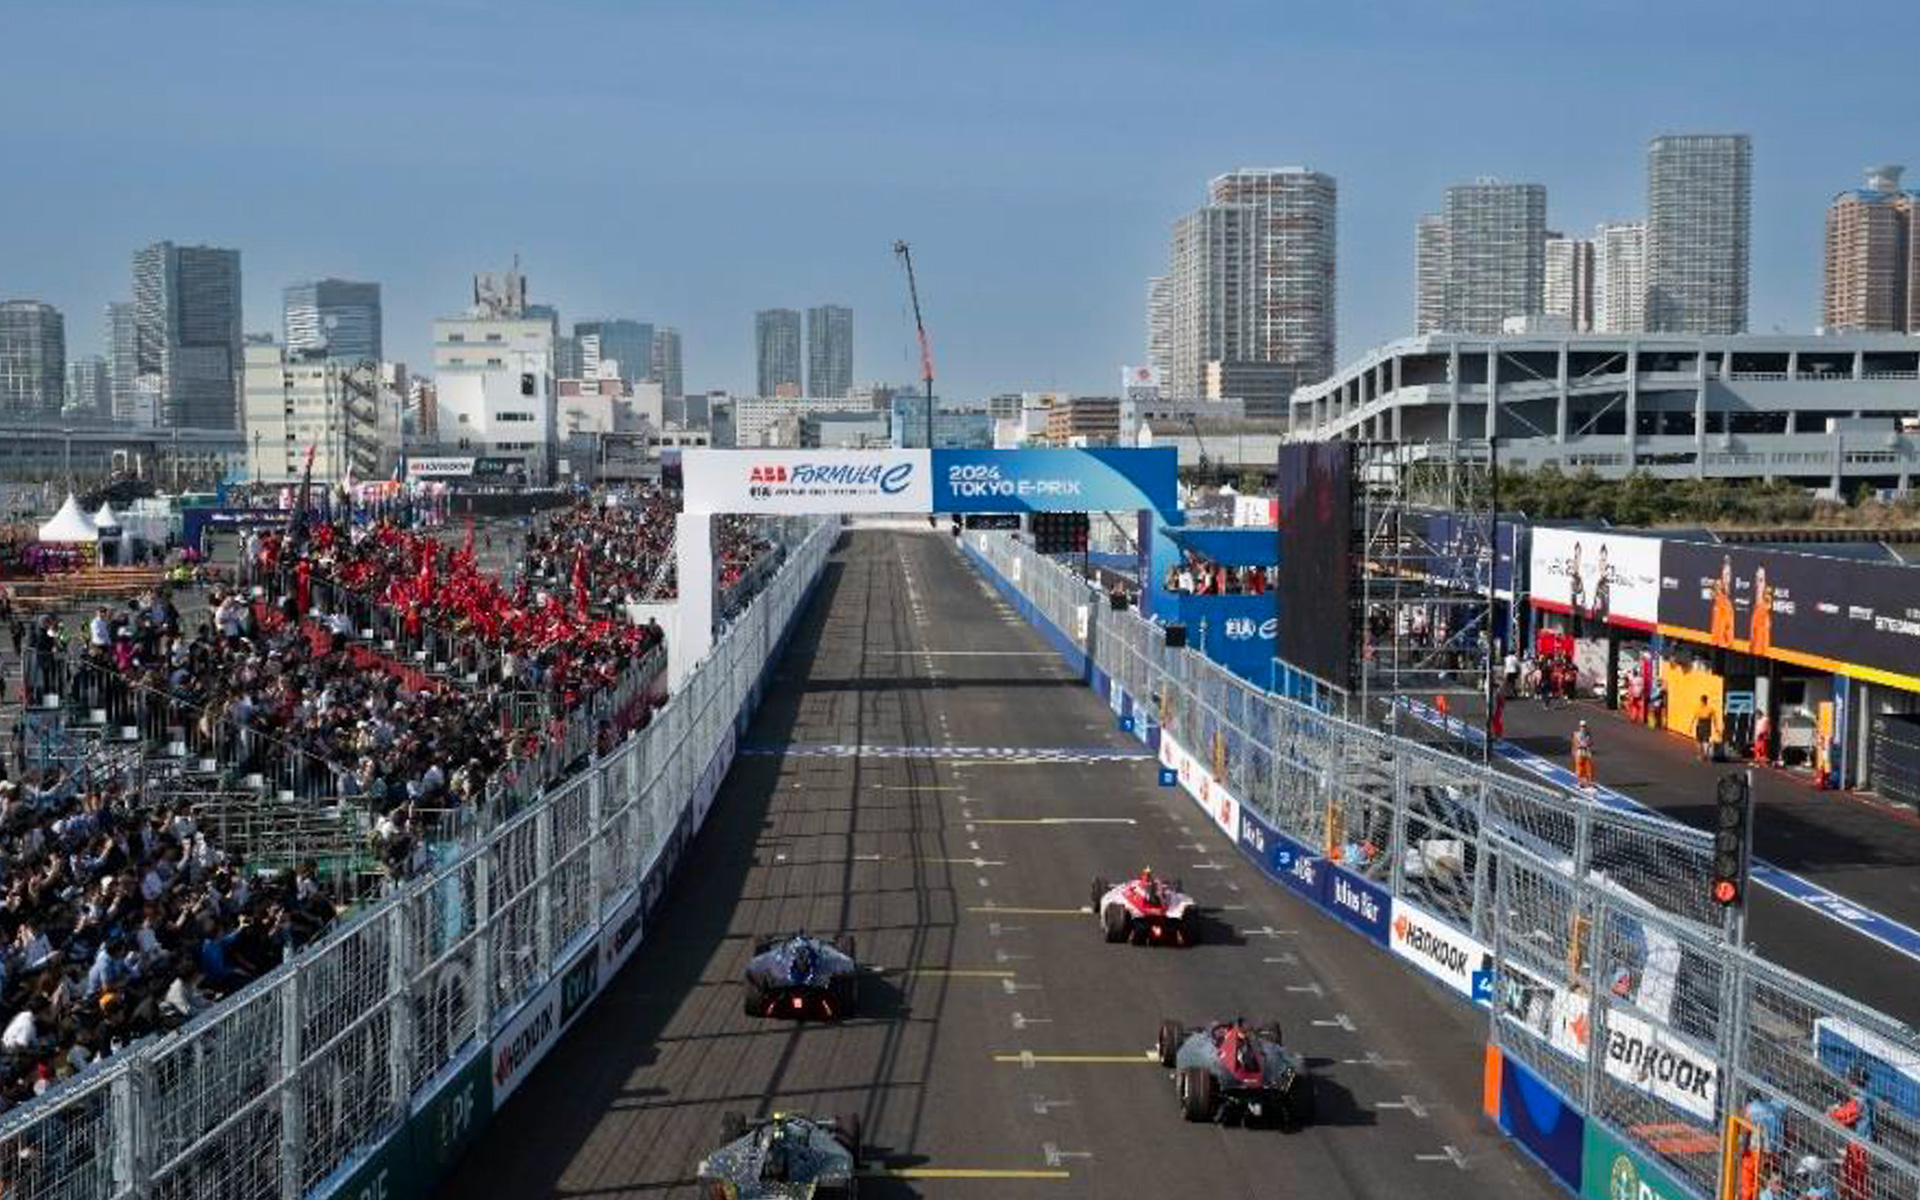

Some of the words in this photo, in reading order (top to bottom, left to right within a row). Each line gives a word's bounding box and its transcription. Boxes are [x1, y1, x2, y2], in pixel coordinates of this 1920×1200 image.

[750, 466, 787, 483] ABB
[790, 464, 882, 484] FORMULA
[949, 465, 1001, 481] 2024
[950, 481, 1015, 497] TOKYO
[1018, 481, 1081, 495] E-PRIX
